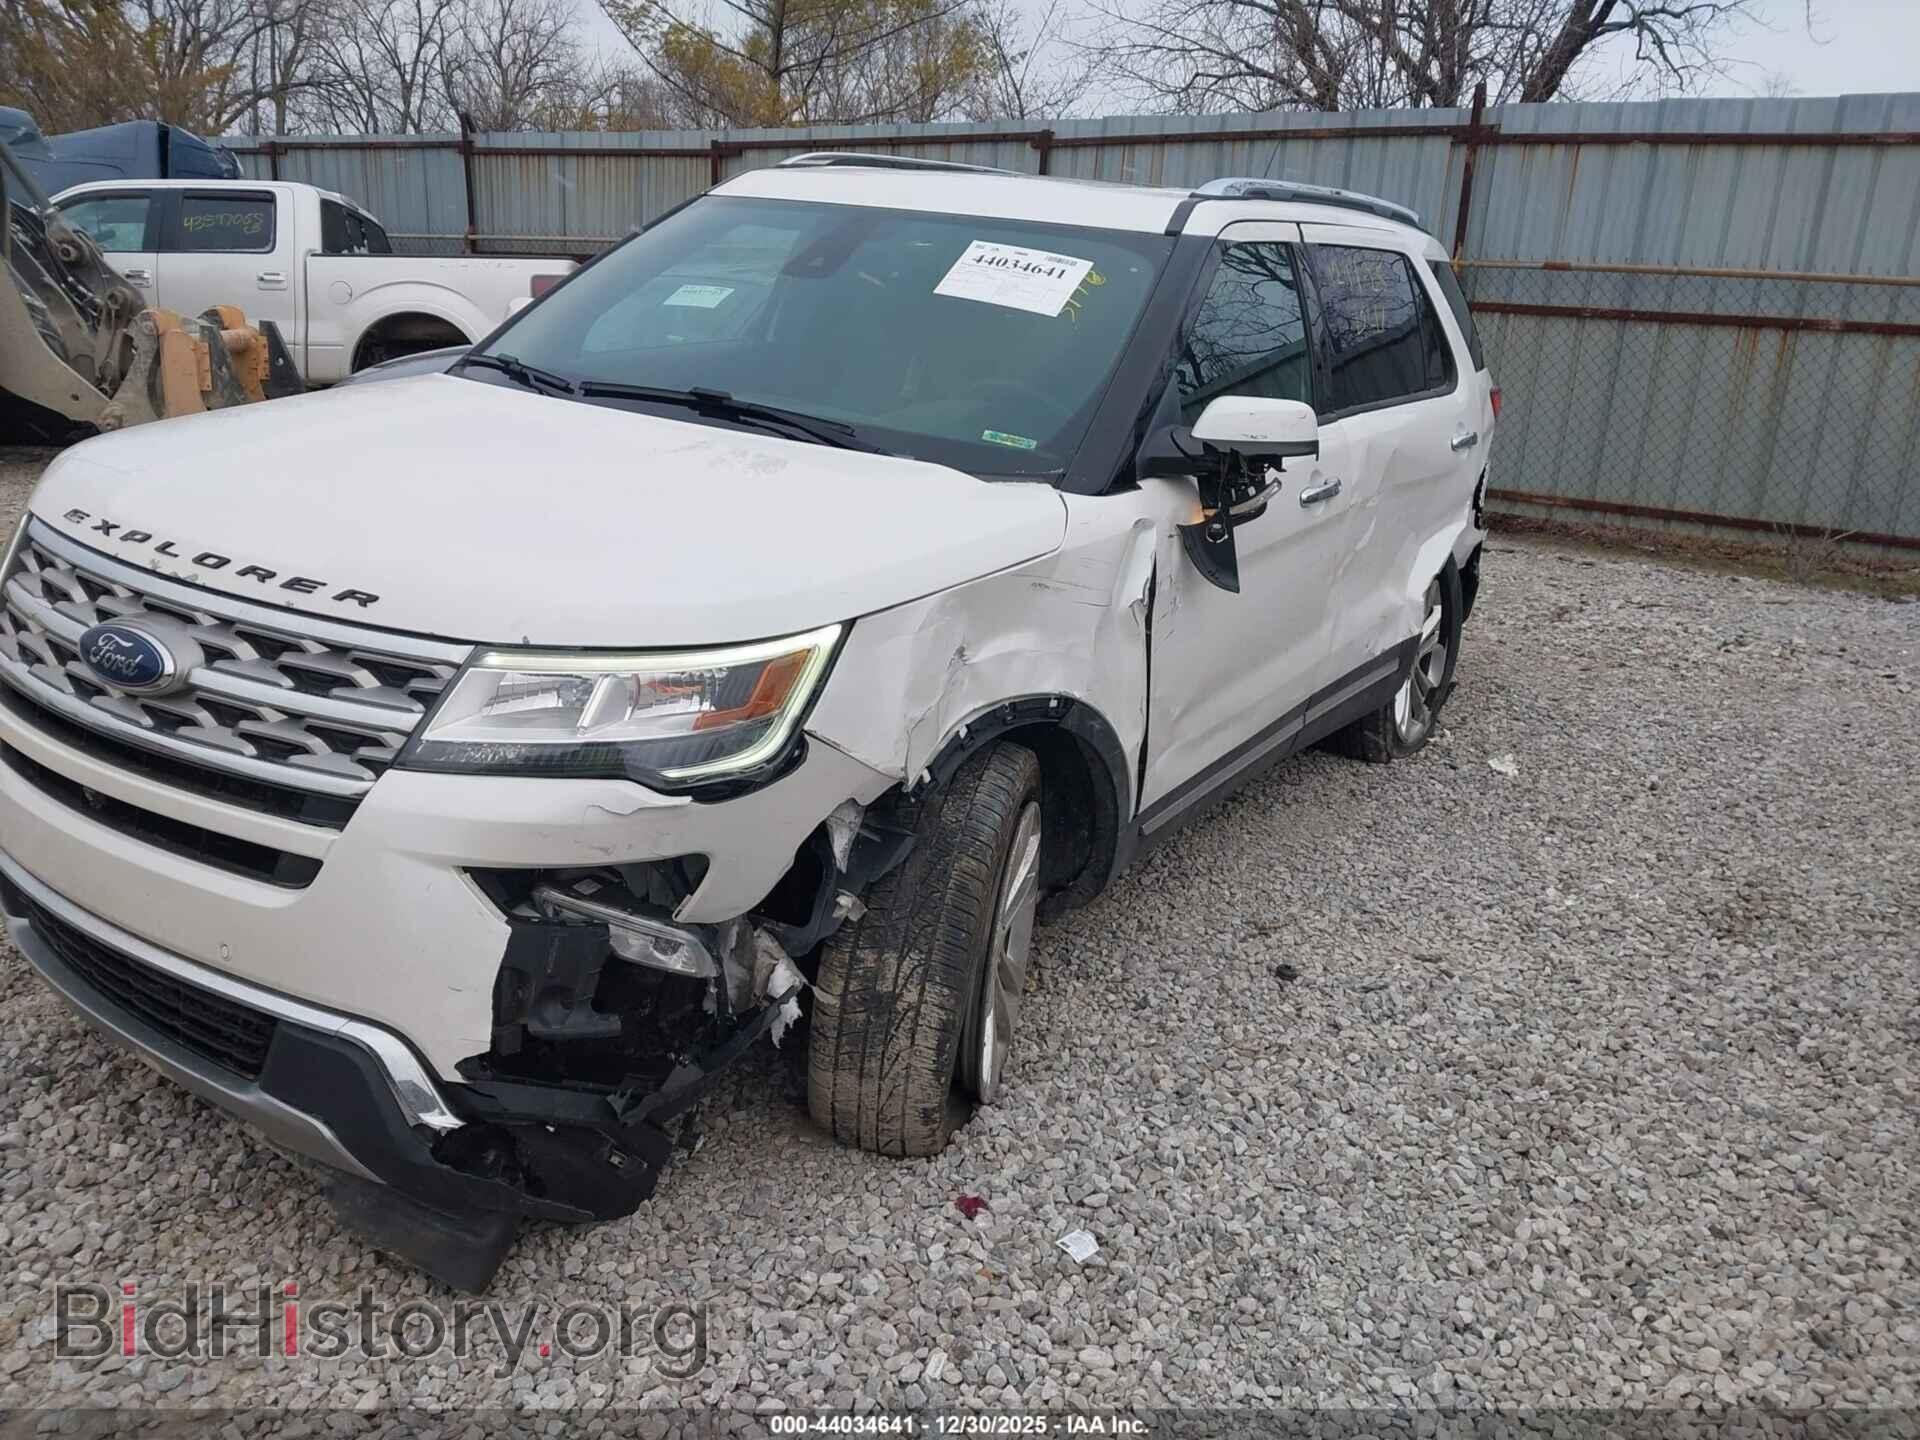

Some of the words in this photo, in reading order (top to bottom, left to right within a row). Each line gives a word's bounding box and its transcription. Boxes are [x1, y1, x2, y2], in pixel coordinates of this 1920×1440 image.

[972, 254, 1066, 279] 44034641
[63, 508, 380, 608] EXPLORER
[89, 632, 142, 678] Ford
